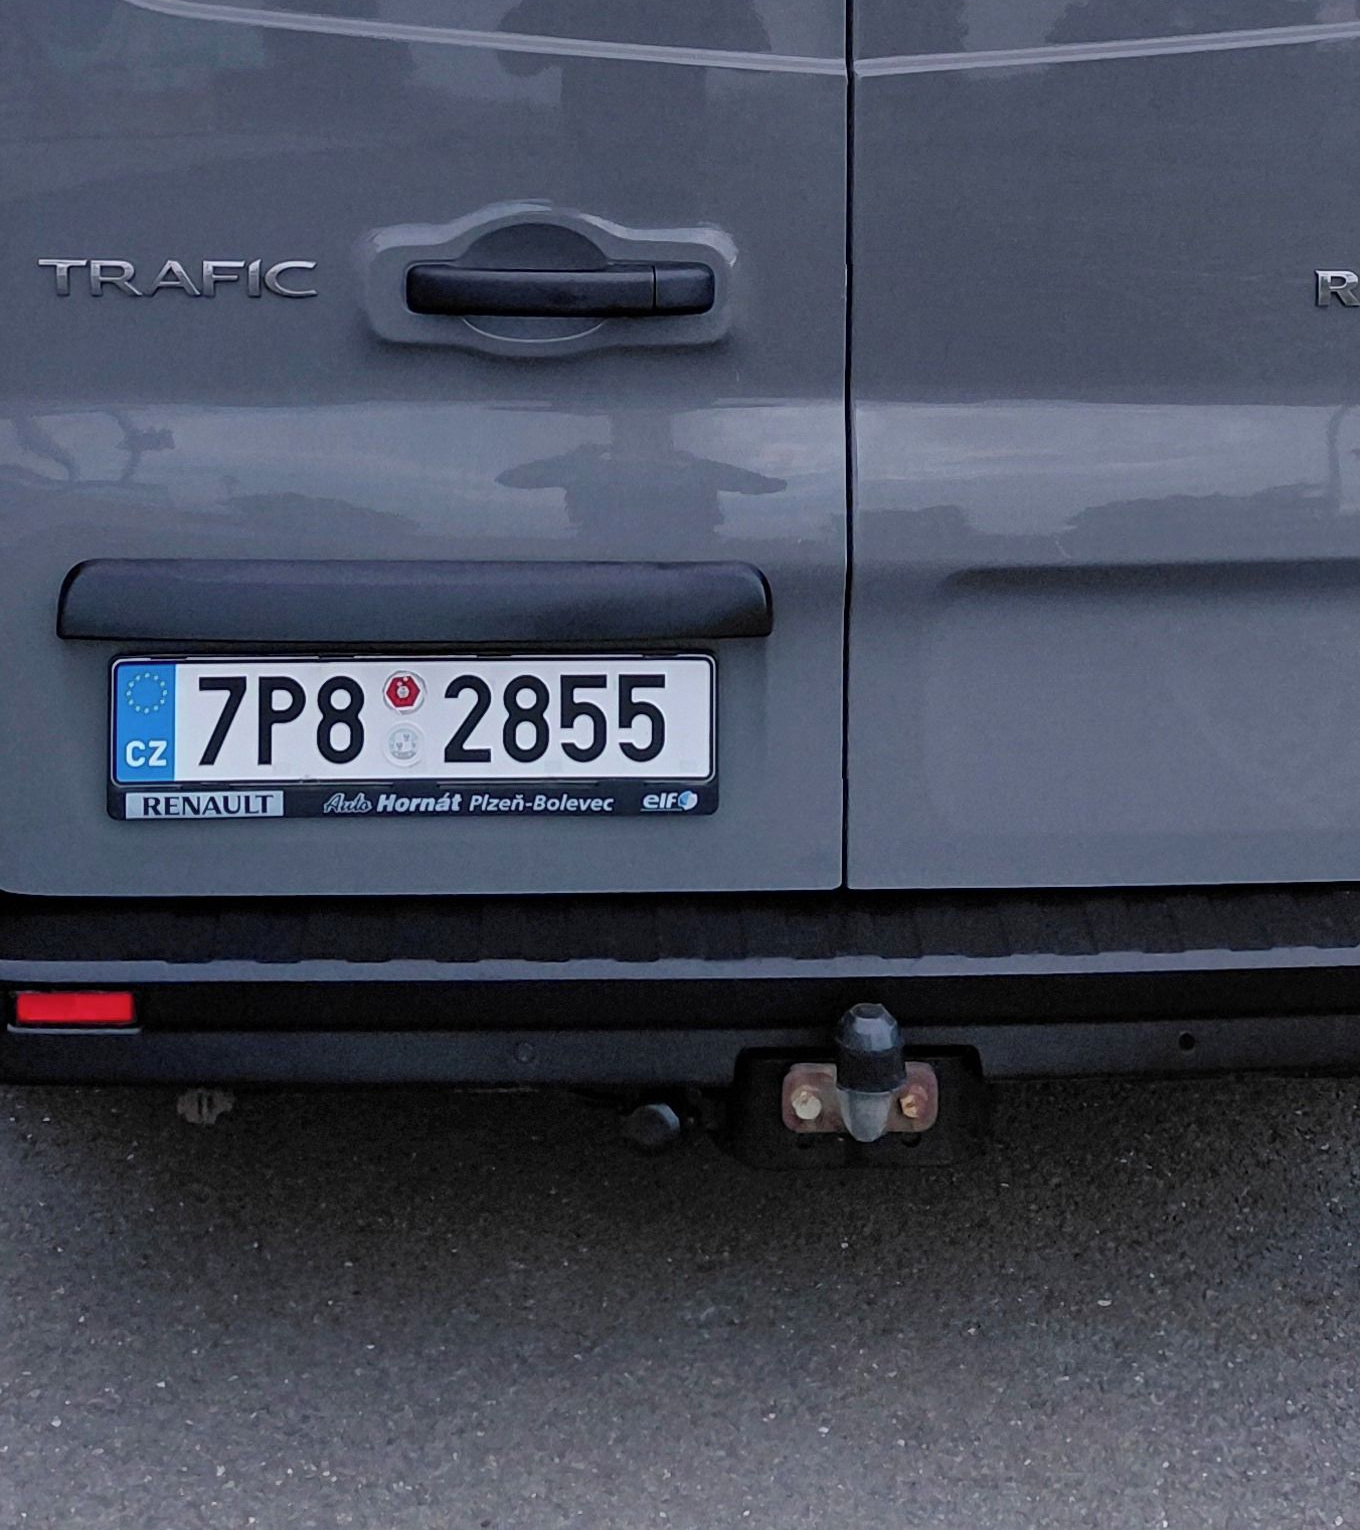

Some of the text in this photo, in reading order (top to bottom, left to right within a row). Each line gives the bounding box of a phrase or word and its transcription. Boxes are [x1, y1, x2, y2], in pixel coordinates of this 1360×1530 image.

[37, 258, 319, 299] TRAFIC
[198, 673, 667, 766] 7P8 2855
[126, 739, 168, 767] CZ
[142, 794, 275, 816] RENAULT
[322, 791, 615, 815] Auto Hornát Plzeň-Bolevec
[642, 791, 680, 810] elf
